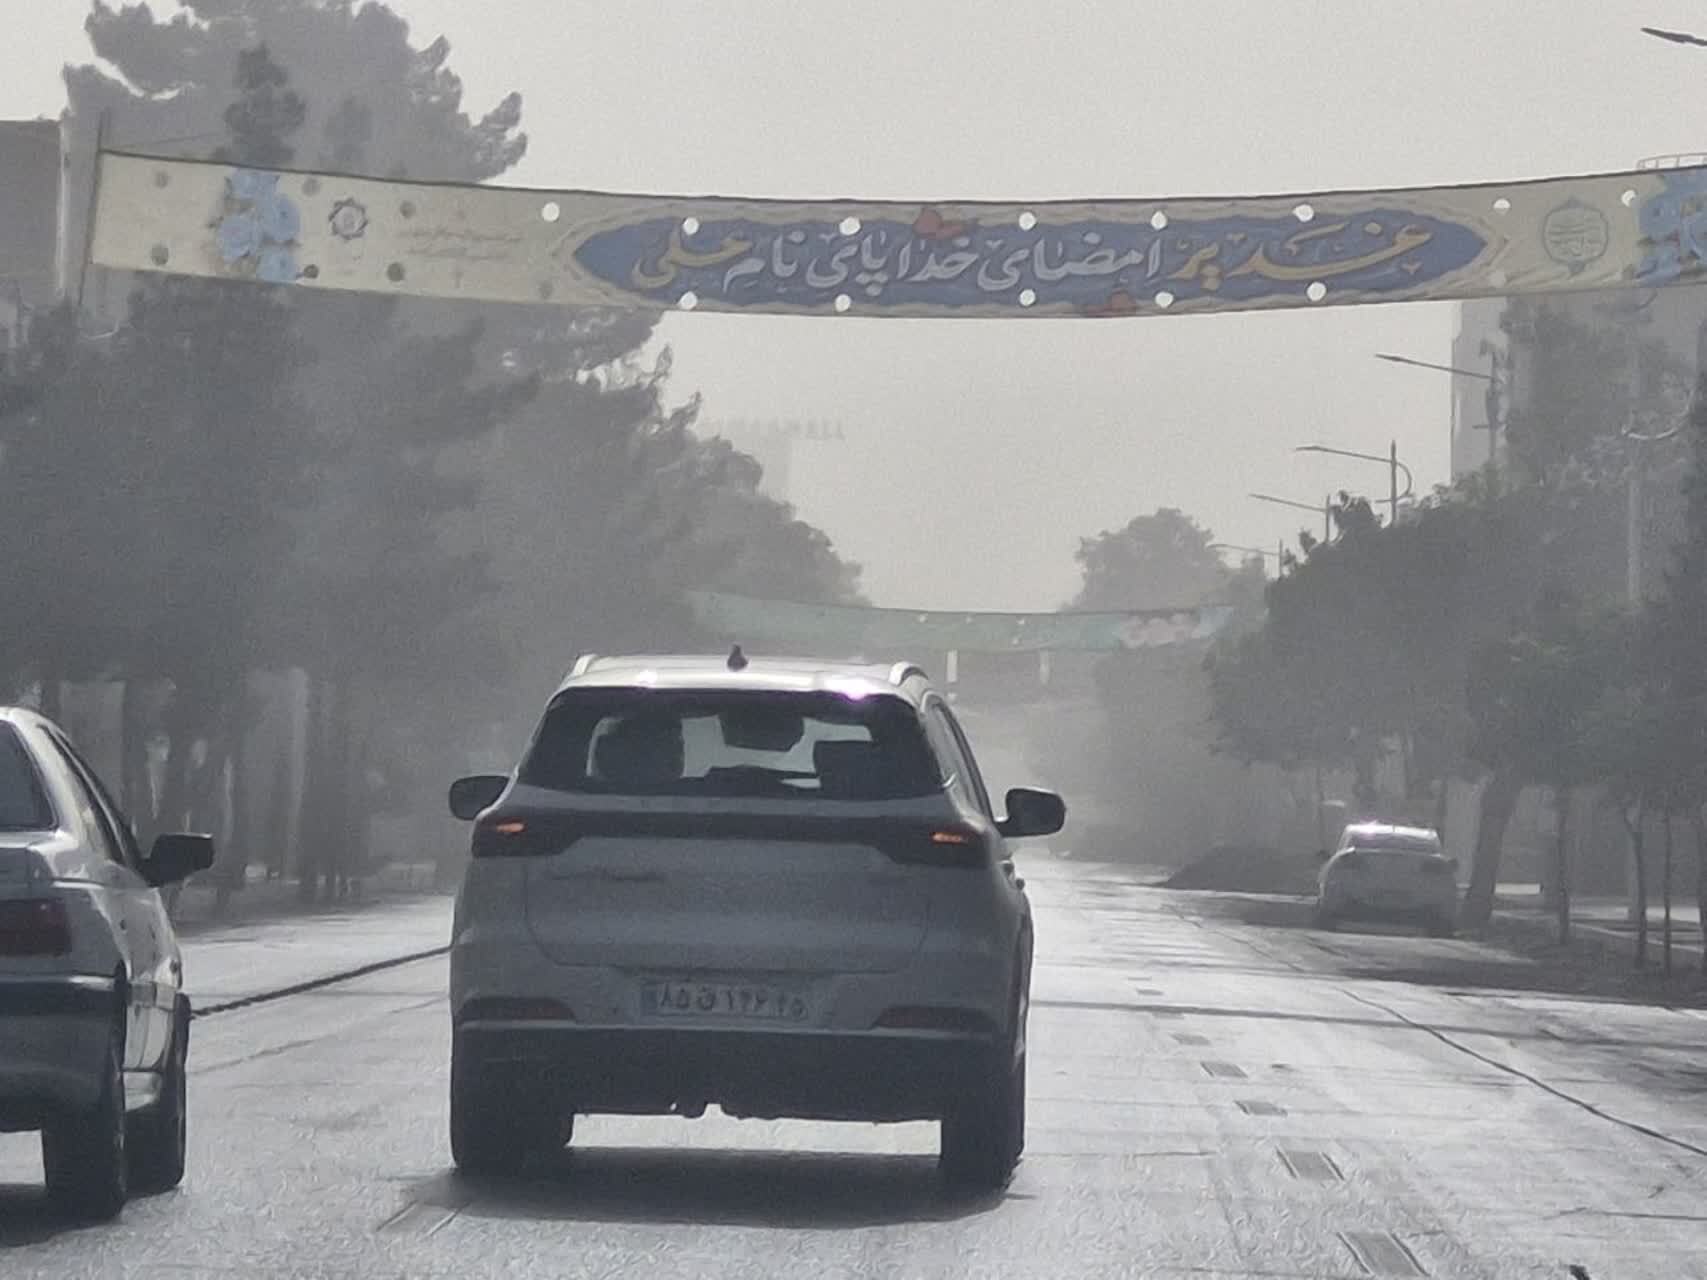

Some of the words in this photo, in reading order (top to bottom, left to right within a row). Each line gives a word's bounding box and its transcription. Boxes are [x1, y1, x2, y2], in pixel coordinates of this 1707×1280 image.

[632, 223, 752, 288] علی
[723, 230, 805, 293] نام
[805, 230, 889, 296] پای
[896, 237, 979, 281] خدا
[976, 231, 1161, 290] امضای
[1167, 222, 1432, 290] غدیر
